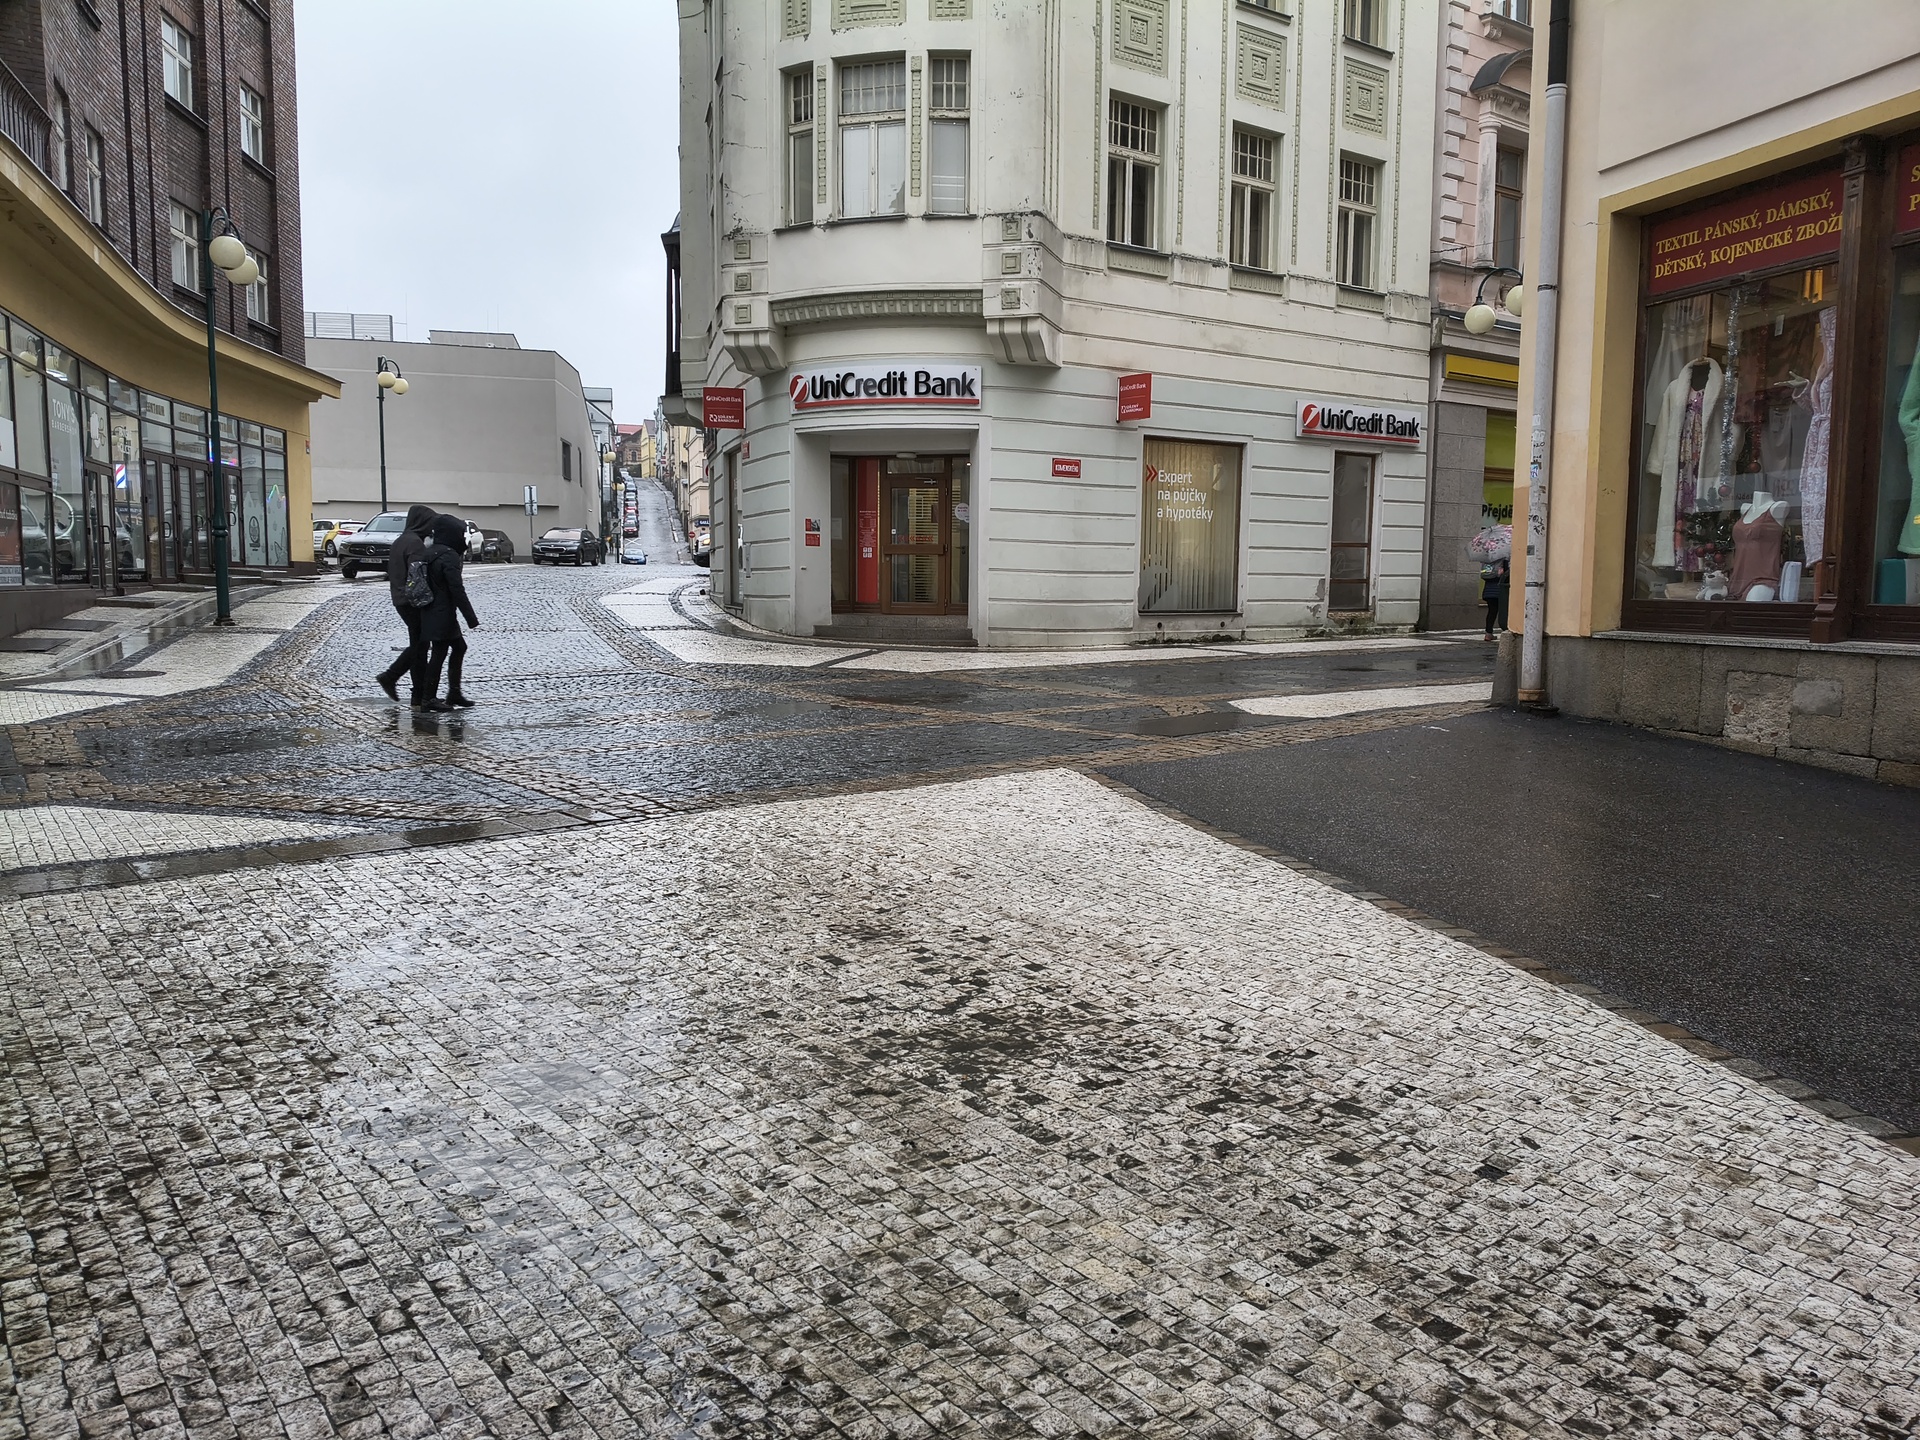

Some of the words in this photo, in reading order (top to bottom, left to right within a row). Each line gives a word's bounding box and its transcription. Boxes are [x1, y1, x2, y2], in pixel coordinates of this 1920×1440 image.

[1656, 230, 1702, 254] TEXTIL
[1704, 209, 1762, 241] PÁNSKÝ,
[1766, 188, 1834, 224] DÁMSKÝ,
[1654, 250, 1707, 278] DĚTSKÝ,
[1710, 227, 1793, 265] KOJENECKÉ
[1795, 211, 1844, 242] ZBOŽÍ
[811, 371, 907, 399] UniCredit
[915, 370, 976, 397] Bank
[1321, 407, 1384, 434] UniCredit
[1387, 414, 1420, 438] Bank
[1158, 470, 1192, 486] Expert
[1158, 490, 1170, 500] na
[1173, 487, 1207, 505] půjčky
[1157, 507, 1163, 518] a
[1166, 505, 1213, 522] hypotéky
